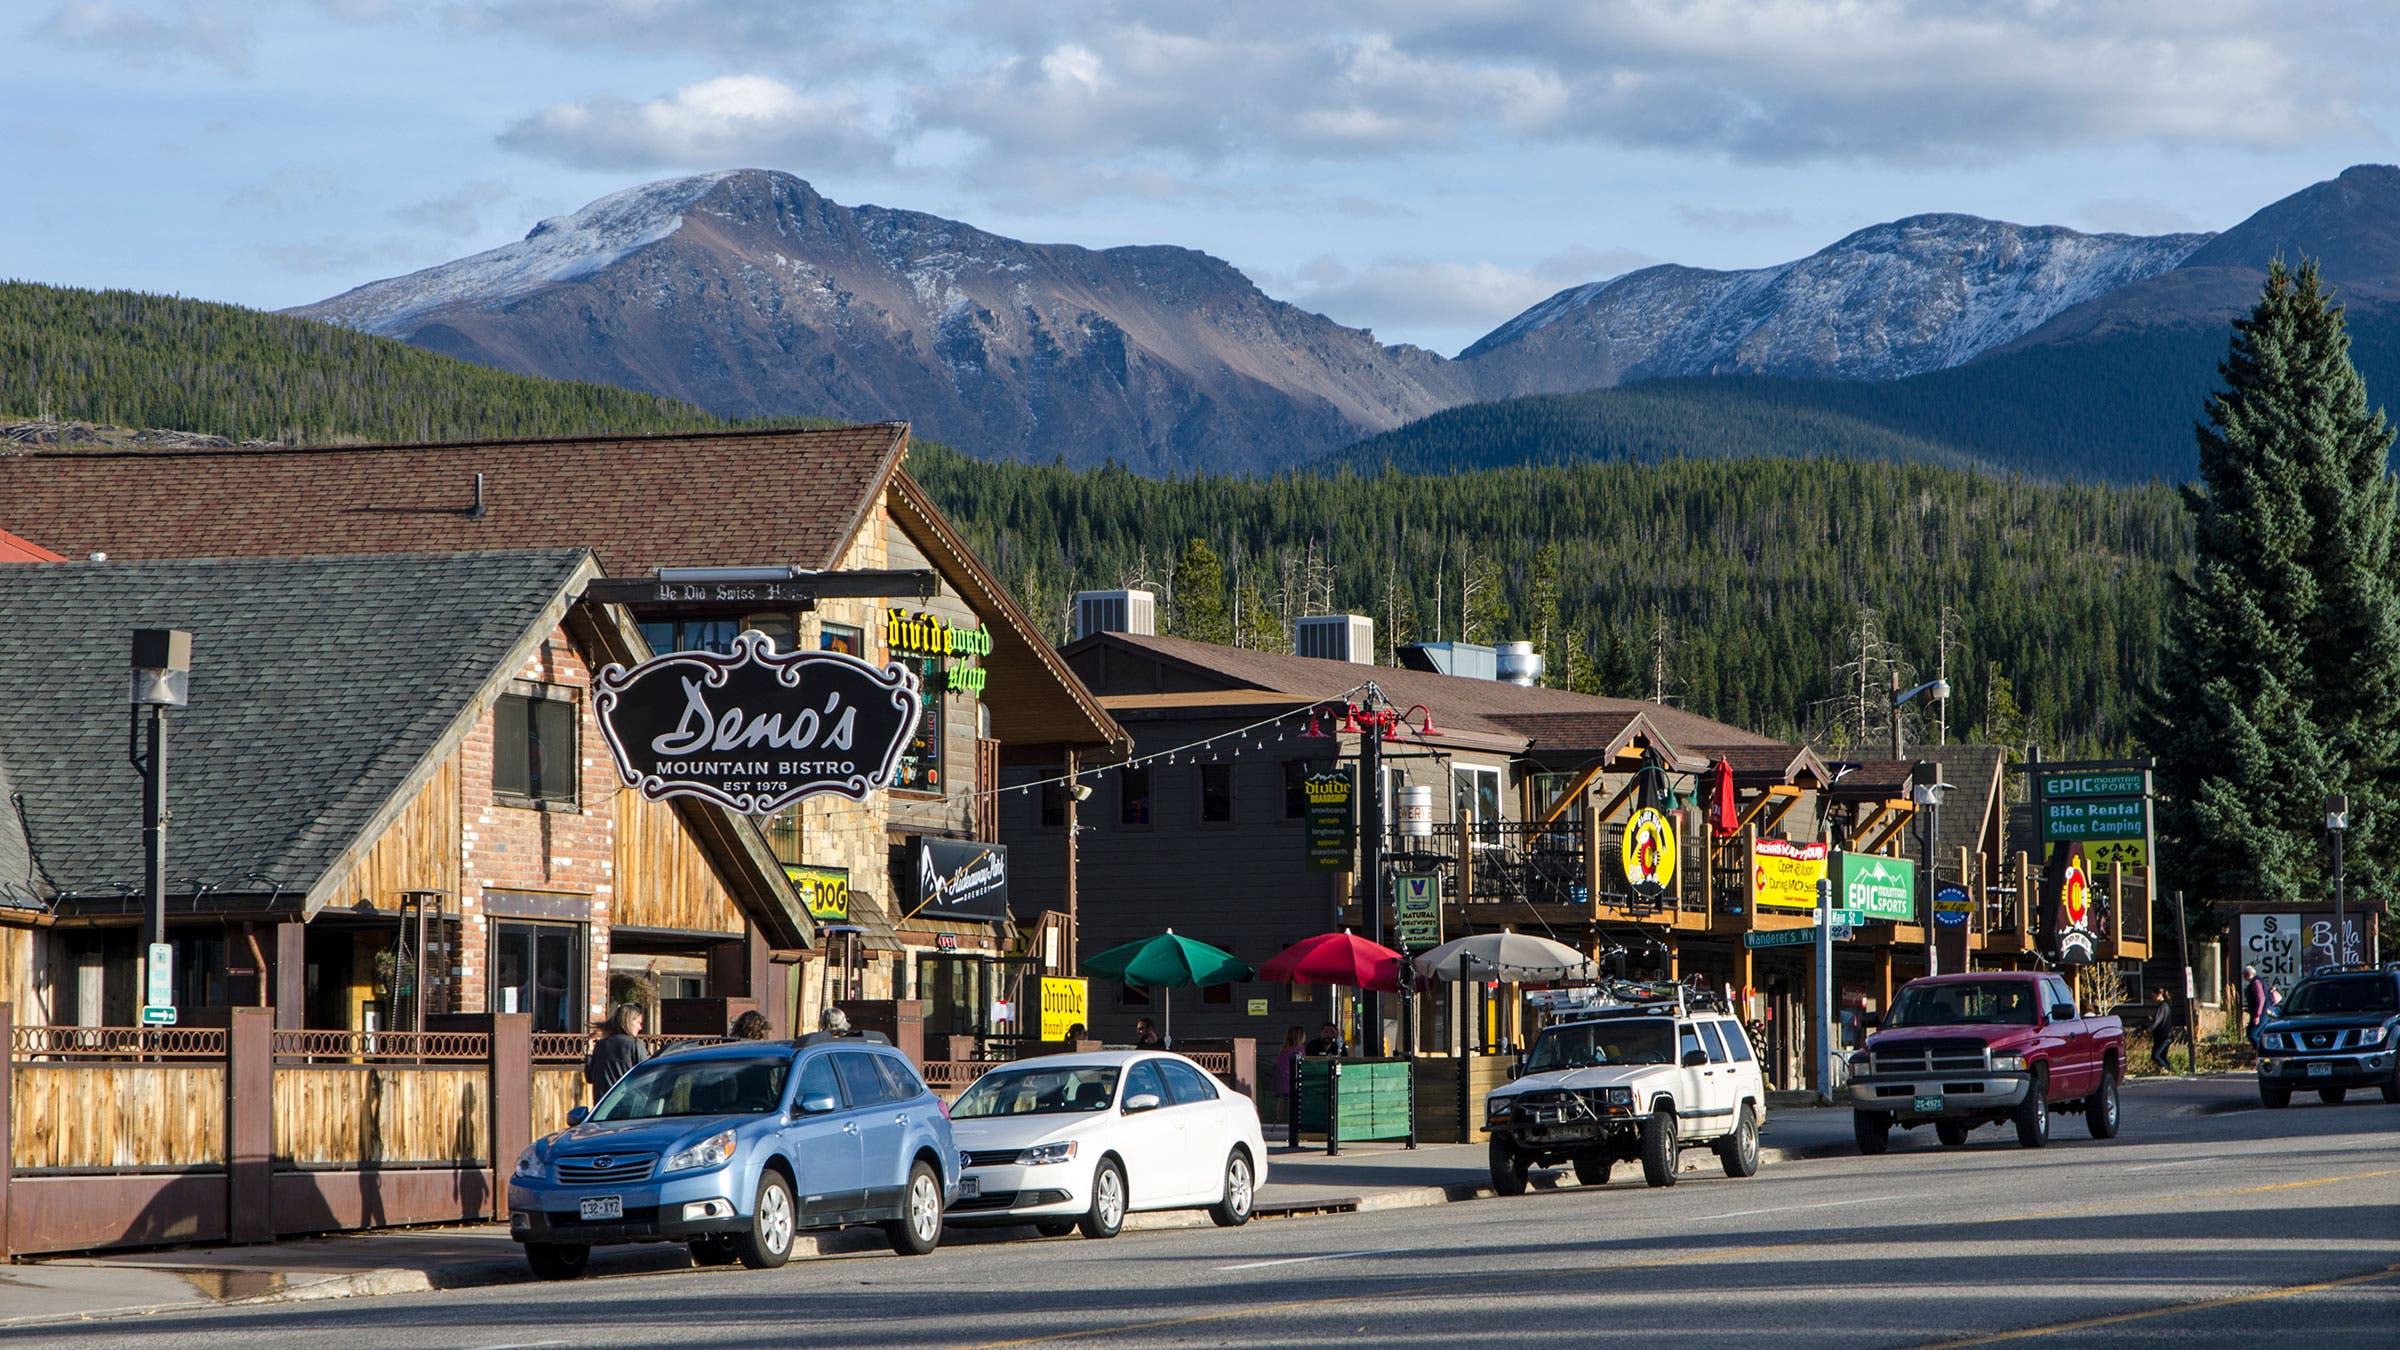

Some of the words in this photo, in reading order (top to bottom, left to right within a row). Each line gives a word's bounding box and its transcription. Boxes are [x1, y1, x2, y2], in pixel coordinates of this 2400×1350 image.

[716, 584, 756, 600] Swiss
[888, 608, 953, 656] divide
[948, 617, 990, 657] board
[948, 656, 986, 698] shop
[652, 676, 857, 755] Deno's
[656, 762, 769, 775] MOUNTAIN
[778, 761, 855, 774] BISTRO
[723, 782, 750, 791] EST
[756, 782, 788, 791] 1976
[1305, 781, 1352, 794] divide
[2047, 779, 2094, 793] EPIC
[2094, 783, 2141, 792] SPORTS
[2050, 804, 2083, 817] Bike
[2088, 803, 2139, 816] Rental
[2051, 821, 2086, 834] Shoes
[2091, 819, 2142, 834] Camping
[2096, 843, 2140, 859] BAR
[949, 866, 989, 896] Hideaway
[987, 852, 1005, 881] Park
[815, 881, 847, 912] DOG
[1849, 883, 1879, 911] EPIC
[1878, 898, 1907, 915] SPORTS
[1832, 911, 1846, 924] Main
[1848, 911, 1856, 925] St
[938, 936, 957, 948] OPEN
[1747, 930, 1796, 946] Wanderer's
[1801, 927, 1815, 940] Wy
[2249, 935, 2293, 957] City
[2262, 957, 2294, 974] Ski
[1044, 984, 1082, 1014] divide
[1043, 1019, 1064, 1035] board
